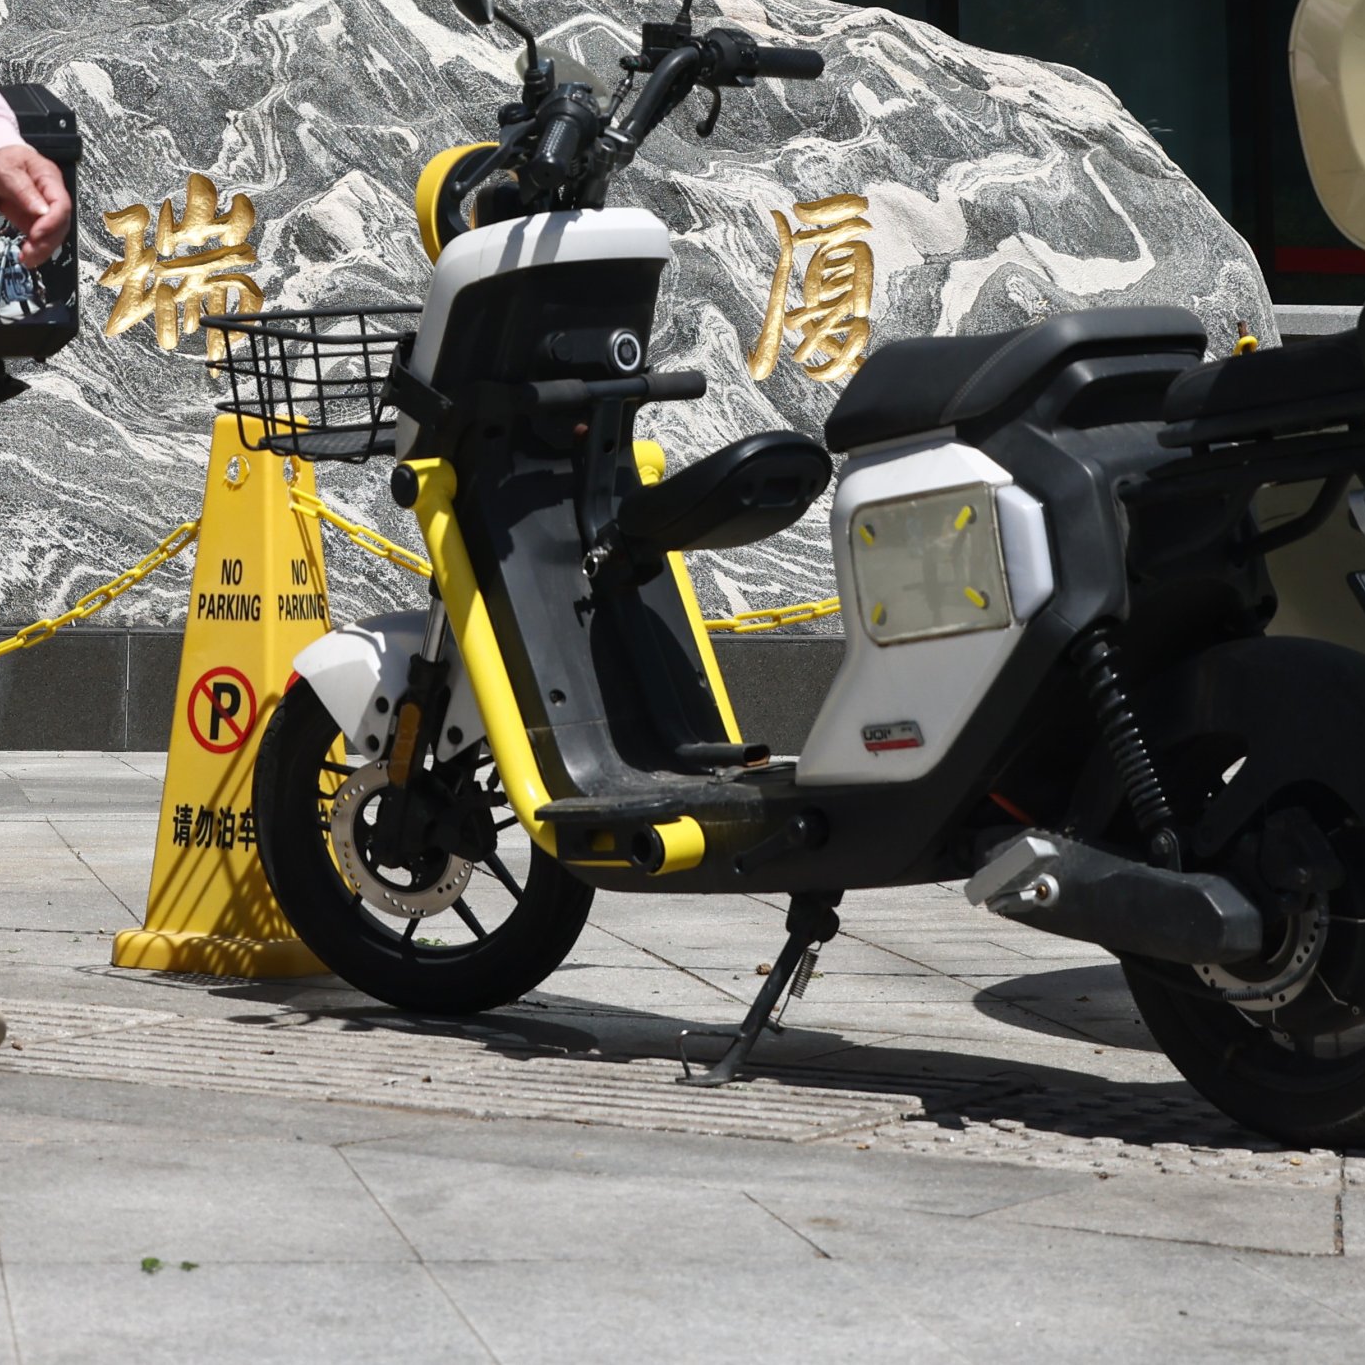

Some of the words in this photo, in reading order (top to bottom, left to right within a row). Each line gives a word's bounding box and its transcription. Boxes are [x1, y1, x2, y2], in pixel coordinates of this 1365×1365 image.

[220, 559, 244, 587] NO
[291, 559, 308, 585] NO
[197, 593, 261, 622] PARKING
[278, 593, 325, 621] PARKING
[172, 804, 257, 853] 请勿泊车
